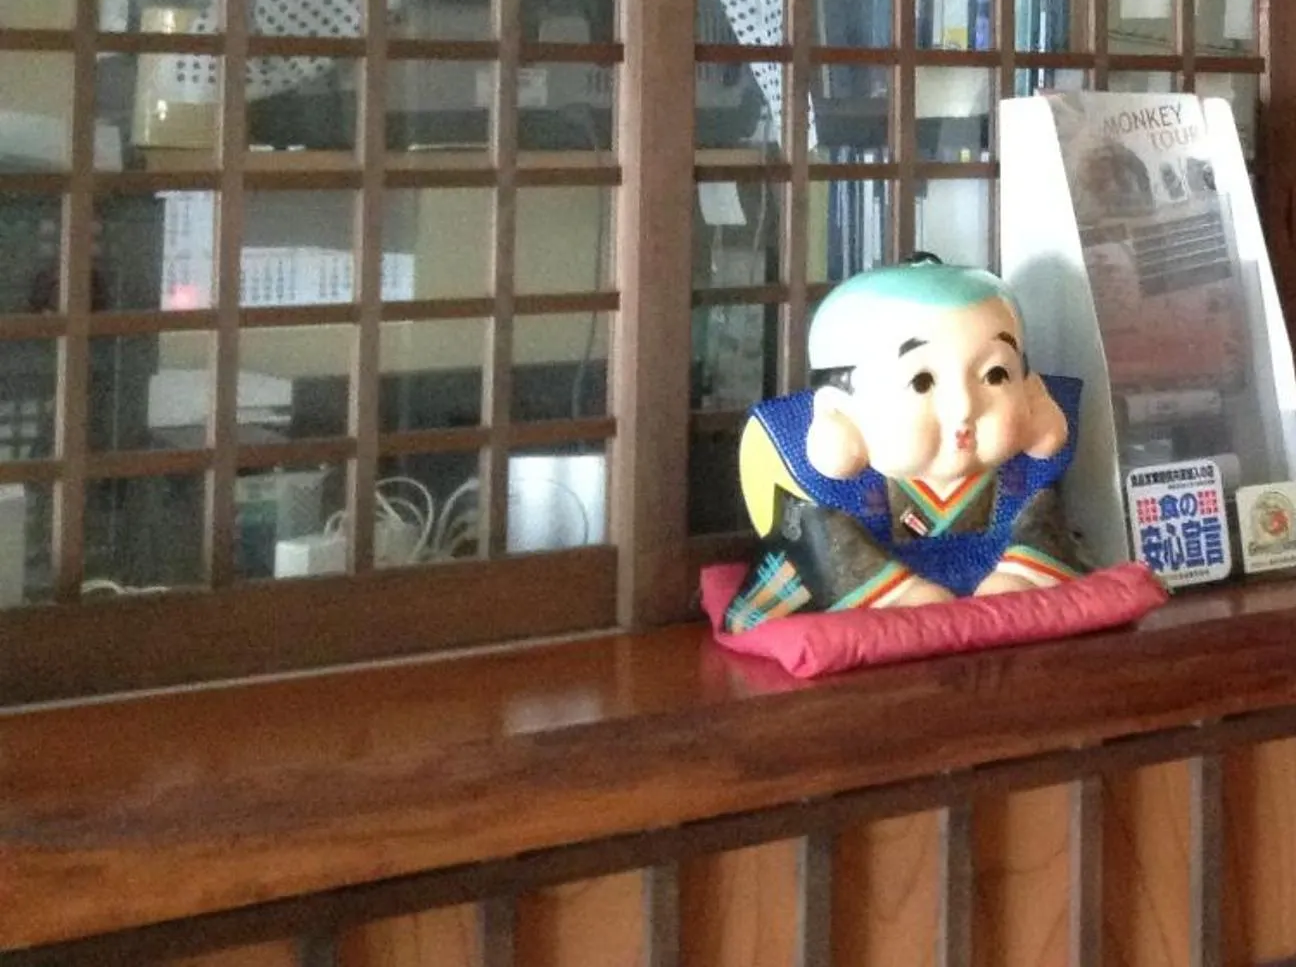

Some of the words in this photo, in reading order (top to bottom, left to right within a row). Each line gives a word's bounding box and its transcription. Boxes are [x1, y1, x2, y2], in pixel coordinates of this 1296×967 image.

[1103, 102, 1183, 139] MONKEY
[1158, 491, 1198, 521] 食の
[1139, 517, 1225, 572] 安心宣言
